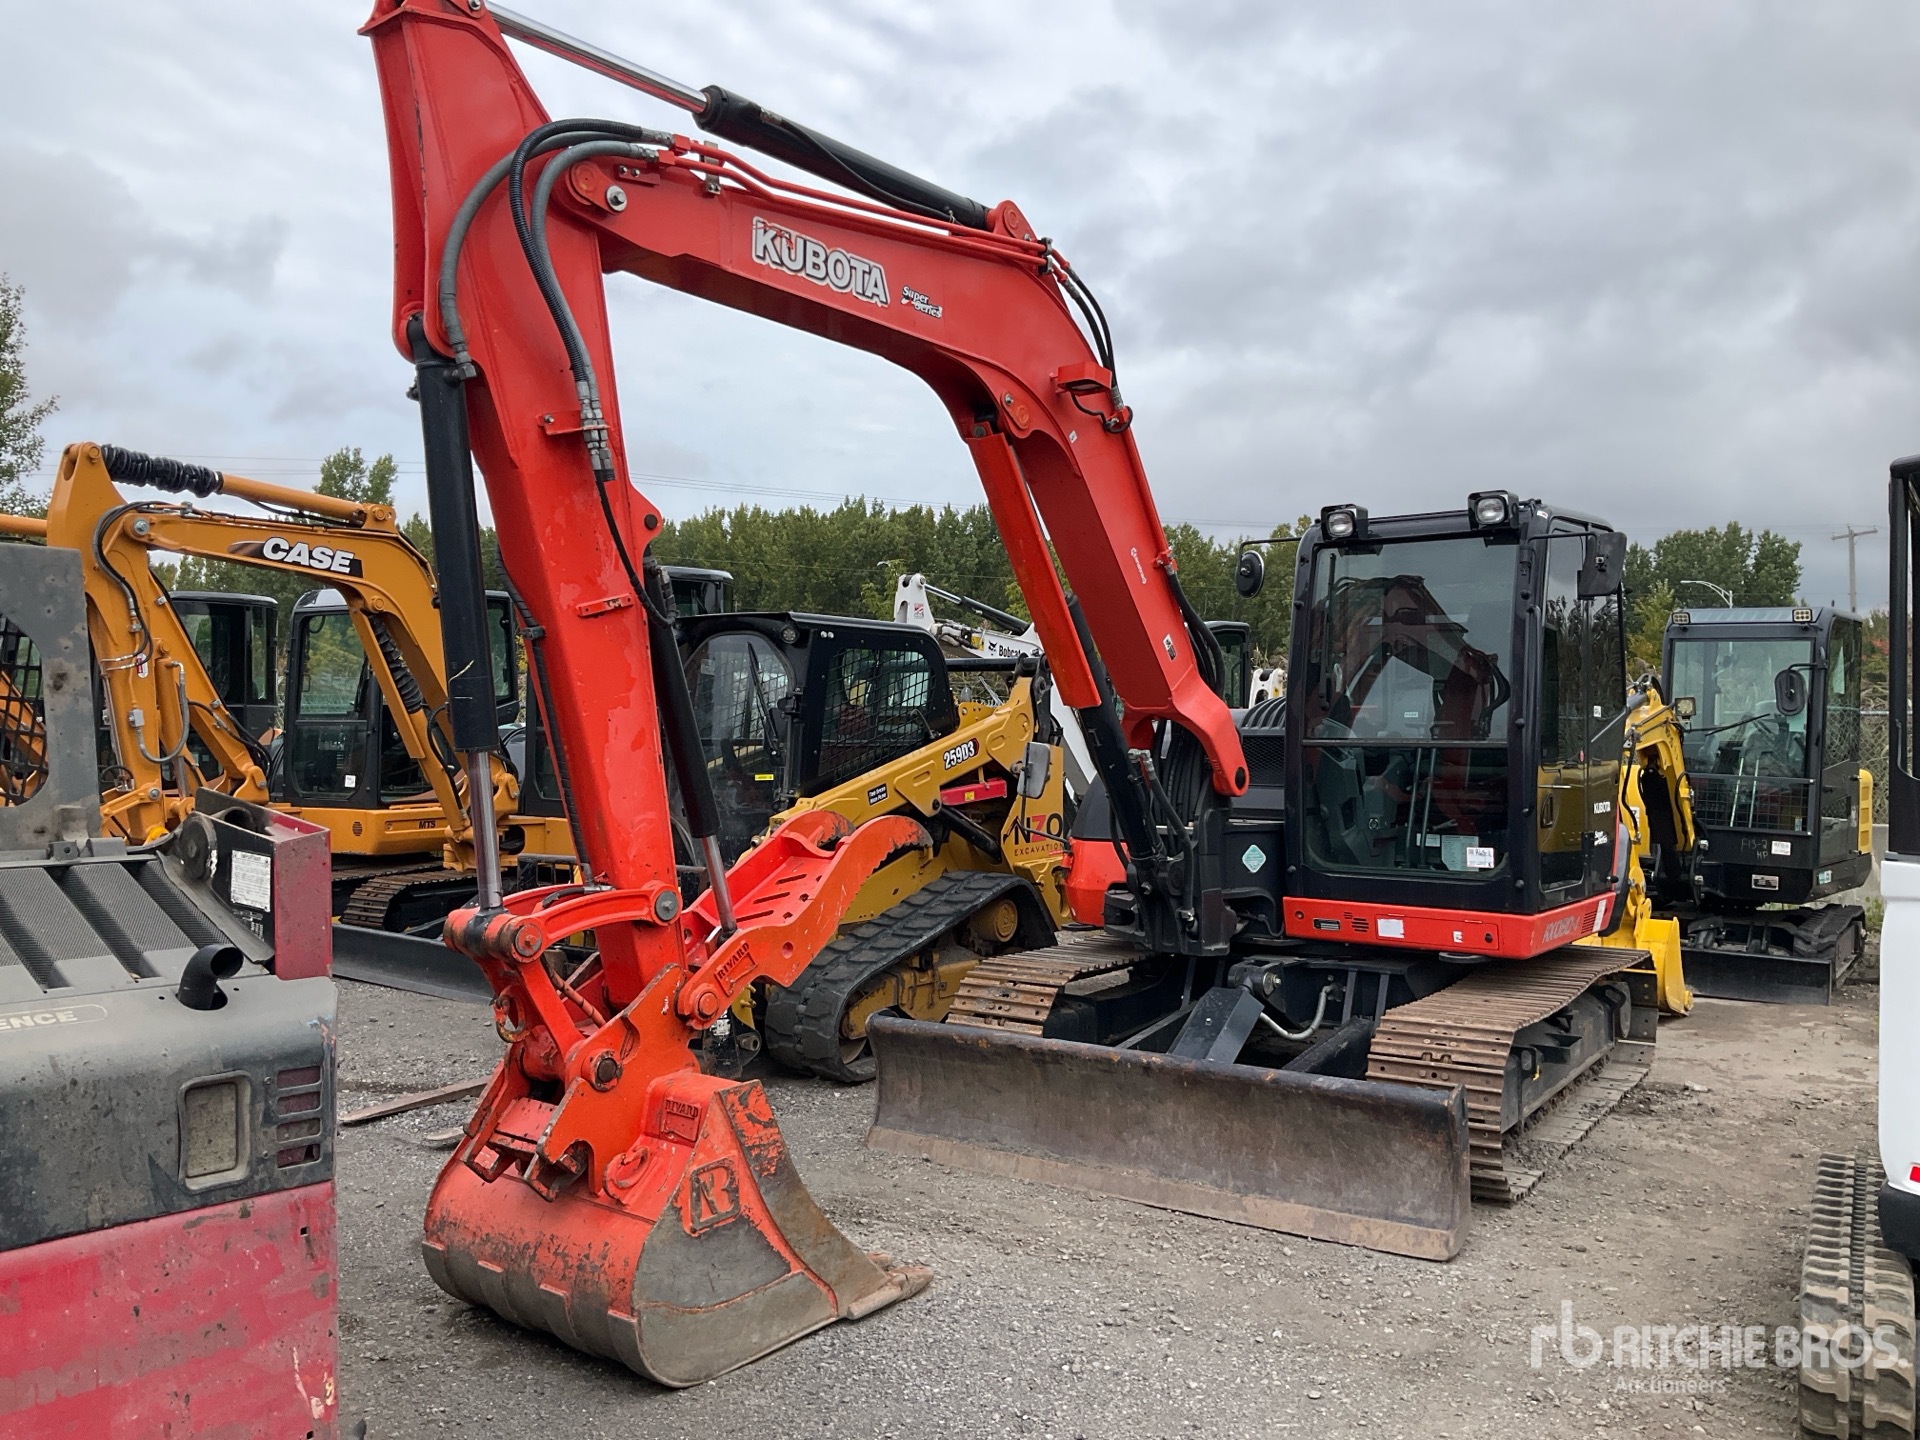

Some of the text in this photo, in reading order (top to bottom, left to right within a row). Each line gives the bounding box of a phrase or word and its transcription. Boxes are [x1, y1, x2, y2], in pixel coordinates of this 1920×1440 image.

[753, 217, 890, 306] KUBOTA
[903, 286, 930, 303] Super
[263, 537, 354, 573] CASE
[944, 740, 975, 770] 259D3
[1594, 801, 1611, 814] KUBOTA
[418, 820, 436, 829] MTS
[1014, 812, 1063, 846] NZO
